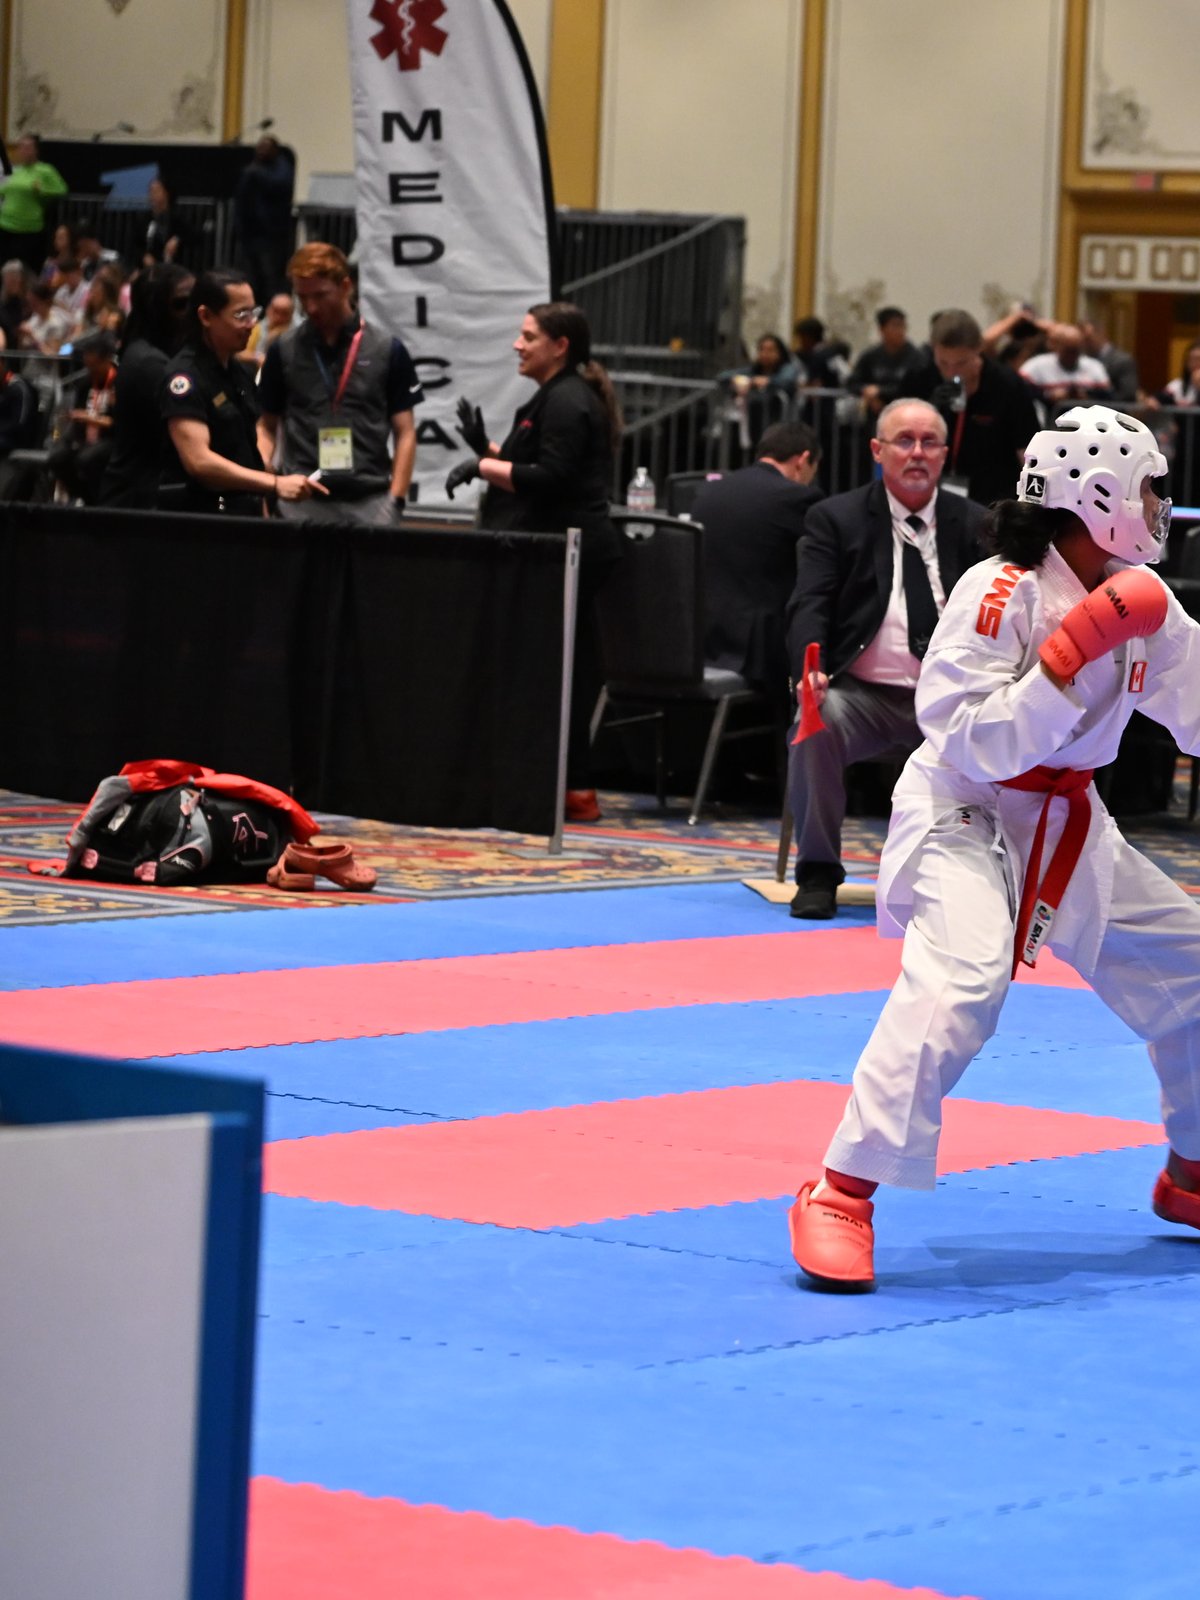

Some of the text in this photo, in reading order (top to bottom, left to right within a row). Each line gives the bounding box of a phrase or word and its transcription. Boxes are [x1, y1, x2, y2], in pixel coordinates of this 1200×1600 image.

[382, 108, 460, 503] MEDICA
[975, 564, 1029, 641] SMA
[1104, 586, 1130, 620] SMAI
[1025, 922, 1044, 955] SMAI
